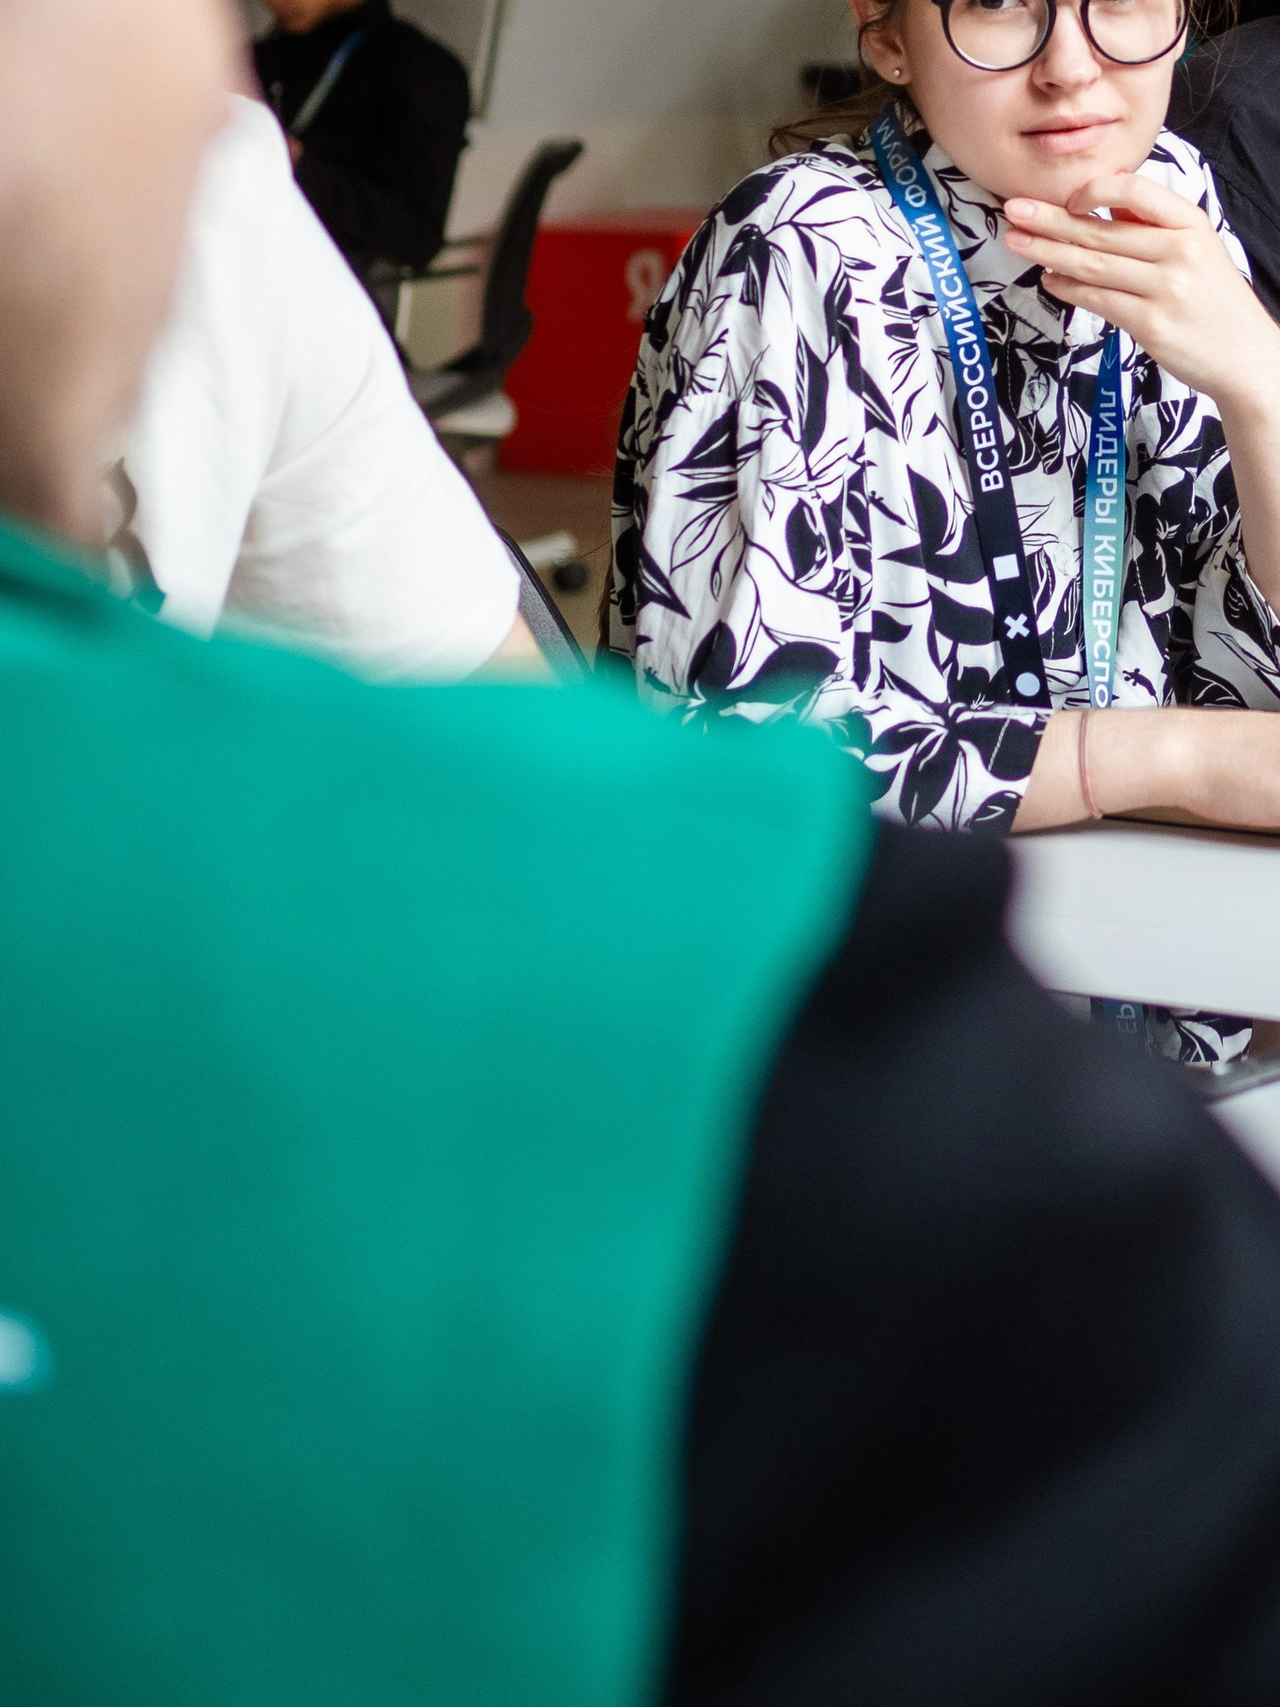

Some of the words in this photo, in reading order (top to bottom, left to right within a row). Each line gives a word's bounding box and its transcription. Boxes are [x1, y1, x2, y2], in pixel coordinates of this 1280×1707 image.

[875, 116, 927, 208] ФОРУМ
[914, 212, 1005, 493] ВСЕРОССИЙСКИЙ
[1094, 387, 1118, 524] ЛИДЕРЫ
